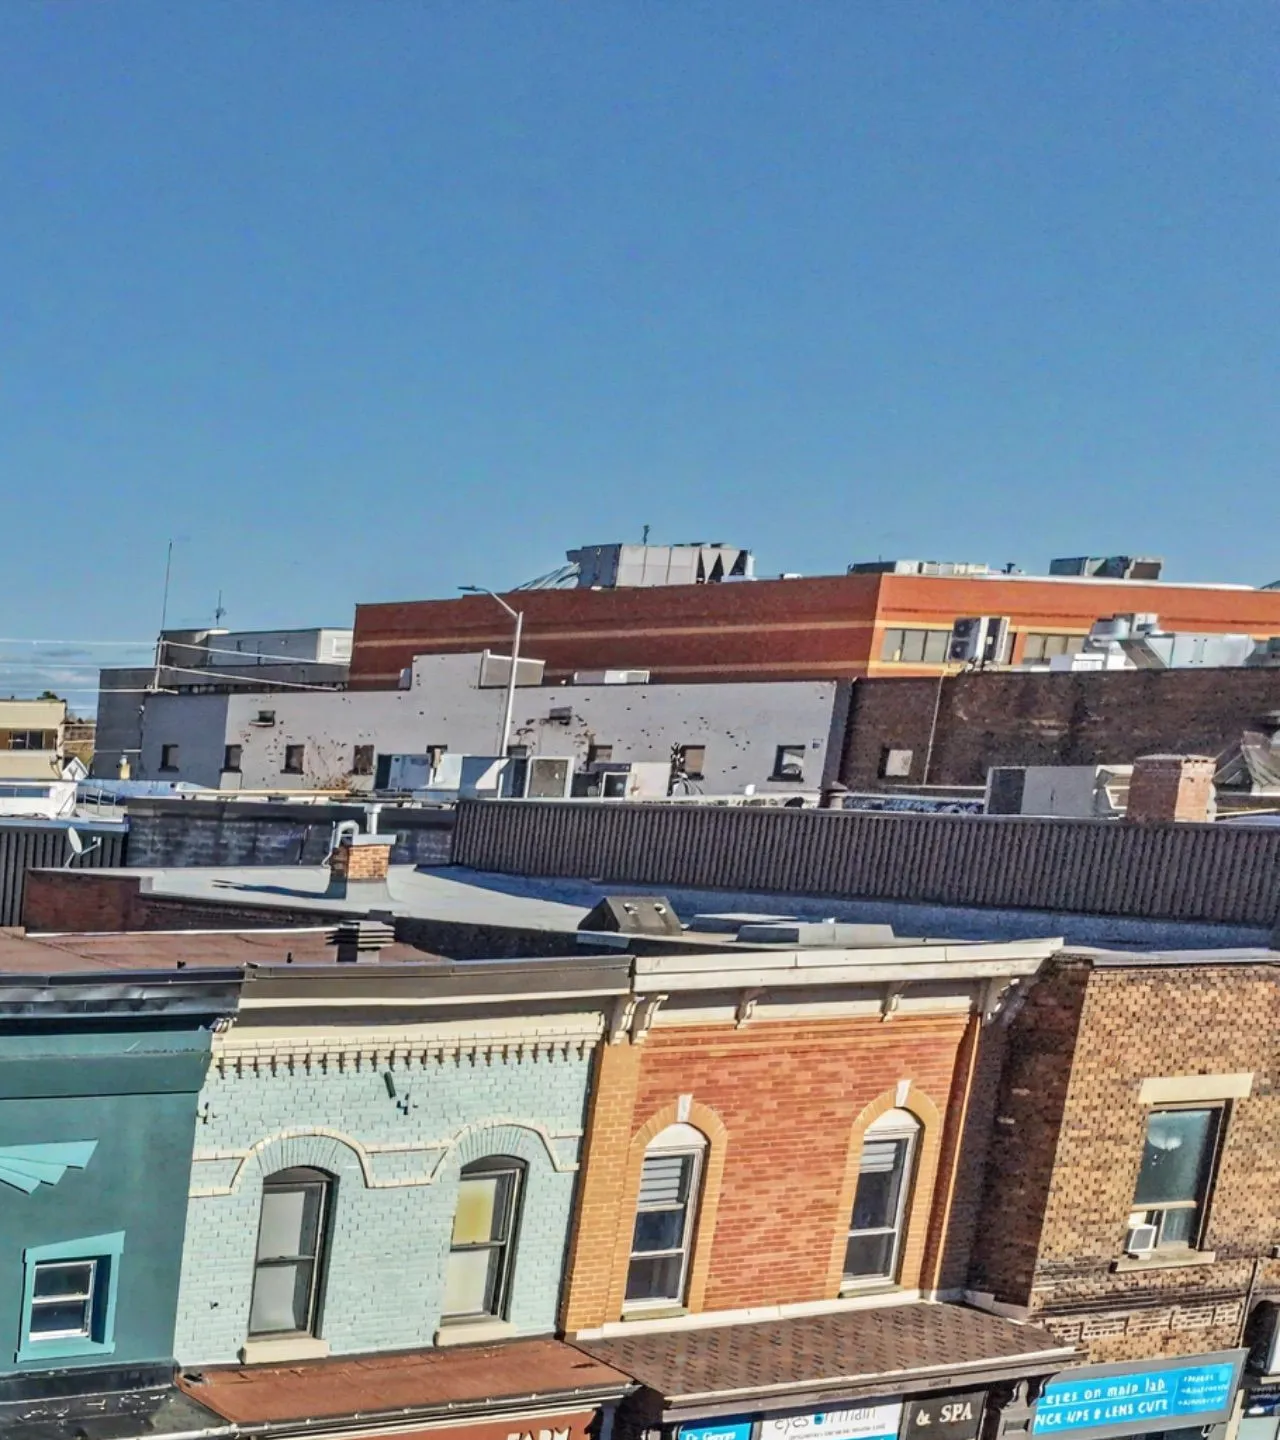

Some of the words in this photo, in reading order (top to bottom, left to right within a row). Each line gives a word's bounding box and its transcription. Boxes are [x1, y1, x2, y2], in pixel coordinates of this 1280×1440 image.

[1084, 1388, 1102, 1400] on
[915, 1409, 931, 1426] &
[940, 1402, 972, 1423] SPA
